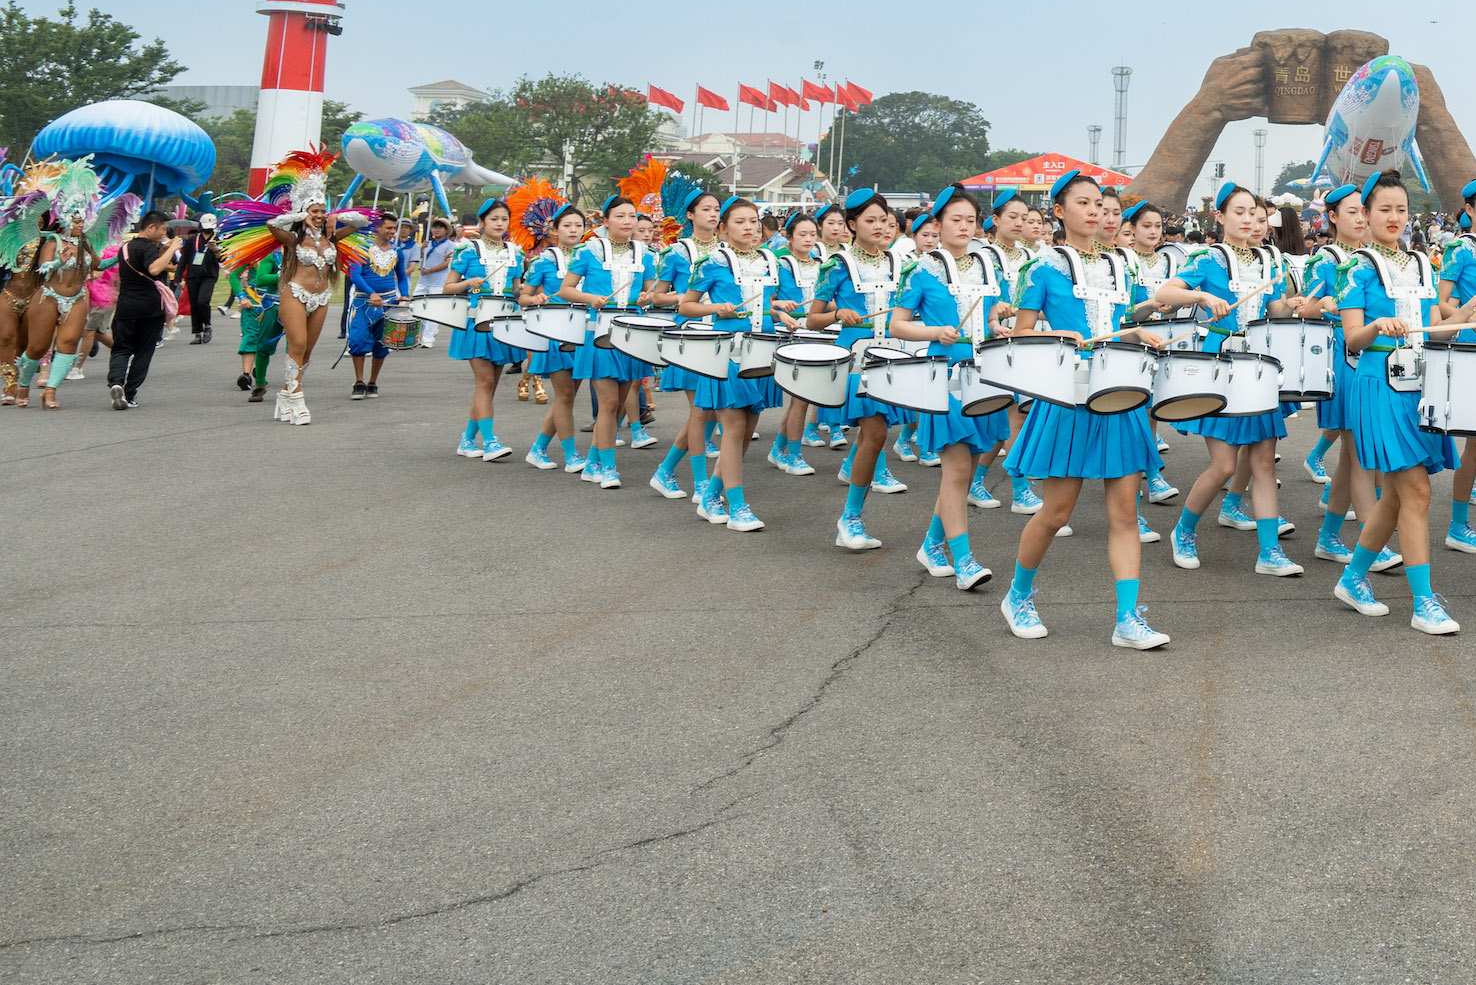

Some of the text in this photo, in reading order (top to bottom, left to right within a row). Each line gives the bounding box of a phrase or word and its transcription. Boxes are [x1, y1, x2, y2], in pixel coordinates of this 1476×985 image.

[1273, 65, 1311, 84] 青岛
[1274, 86, 1315, 96] QINGDAO
[1043, 161, 1065, 169] 主入口
